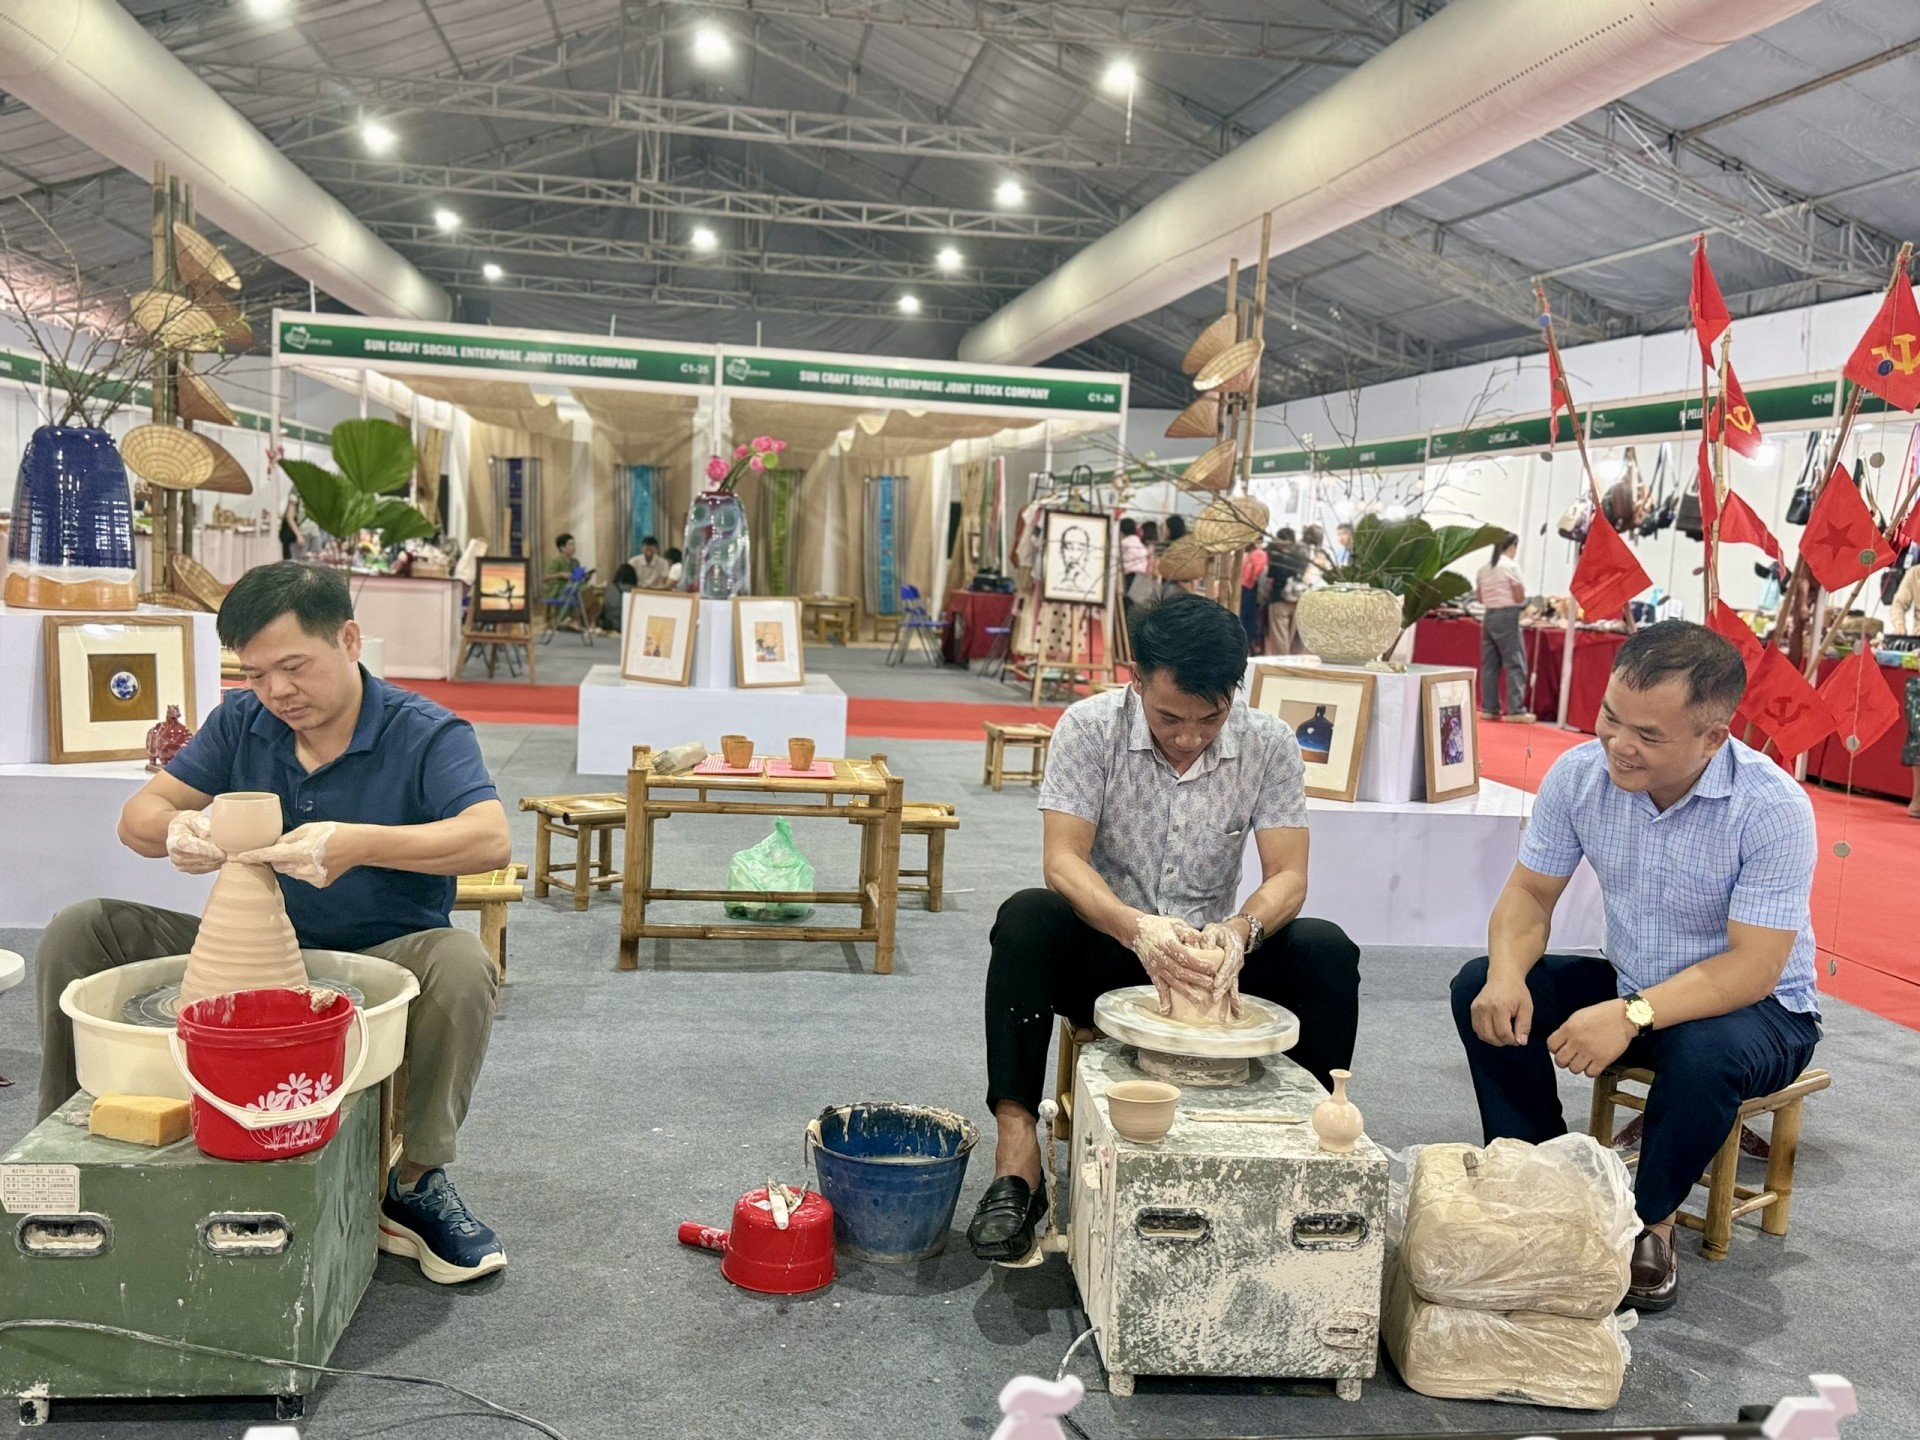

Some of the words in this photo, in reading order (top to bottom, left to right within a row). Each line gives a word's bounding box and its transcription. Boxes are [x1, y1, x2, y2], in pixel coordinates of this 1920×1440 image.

[364, 338, 387, 352] SUN
[388, 341, 421, 355] CRAFT
[422, 343, 458, 358] SOCIAL
[460, 346, 521, 362] ENTERPRISE
[524, 351, 554, 365] JOINT
[555, 353, 589, 367] STOCK
[590, 355, 638, 370] COMPANY
[799, 370, 820, 383] SUN
[821, 372, 851, 385] CRAFT
[852, 374, 885, 388] SOCIAL
[887, 377, 944, 393] ENTERPRISE
[945, 381, 973, 395] JOINT
[973, 384, 1004, 397] STOCK
[1005, 386, 1050, 401] COMPANY
